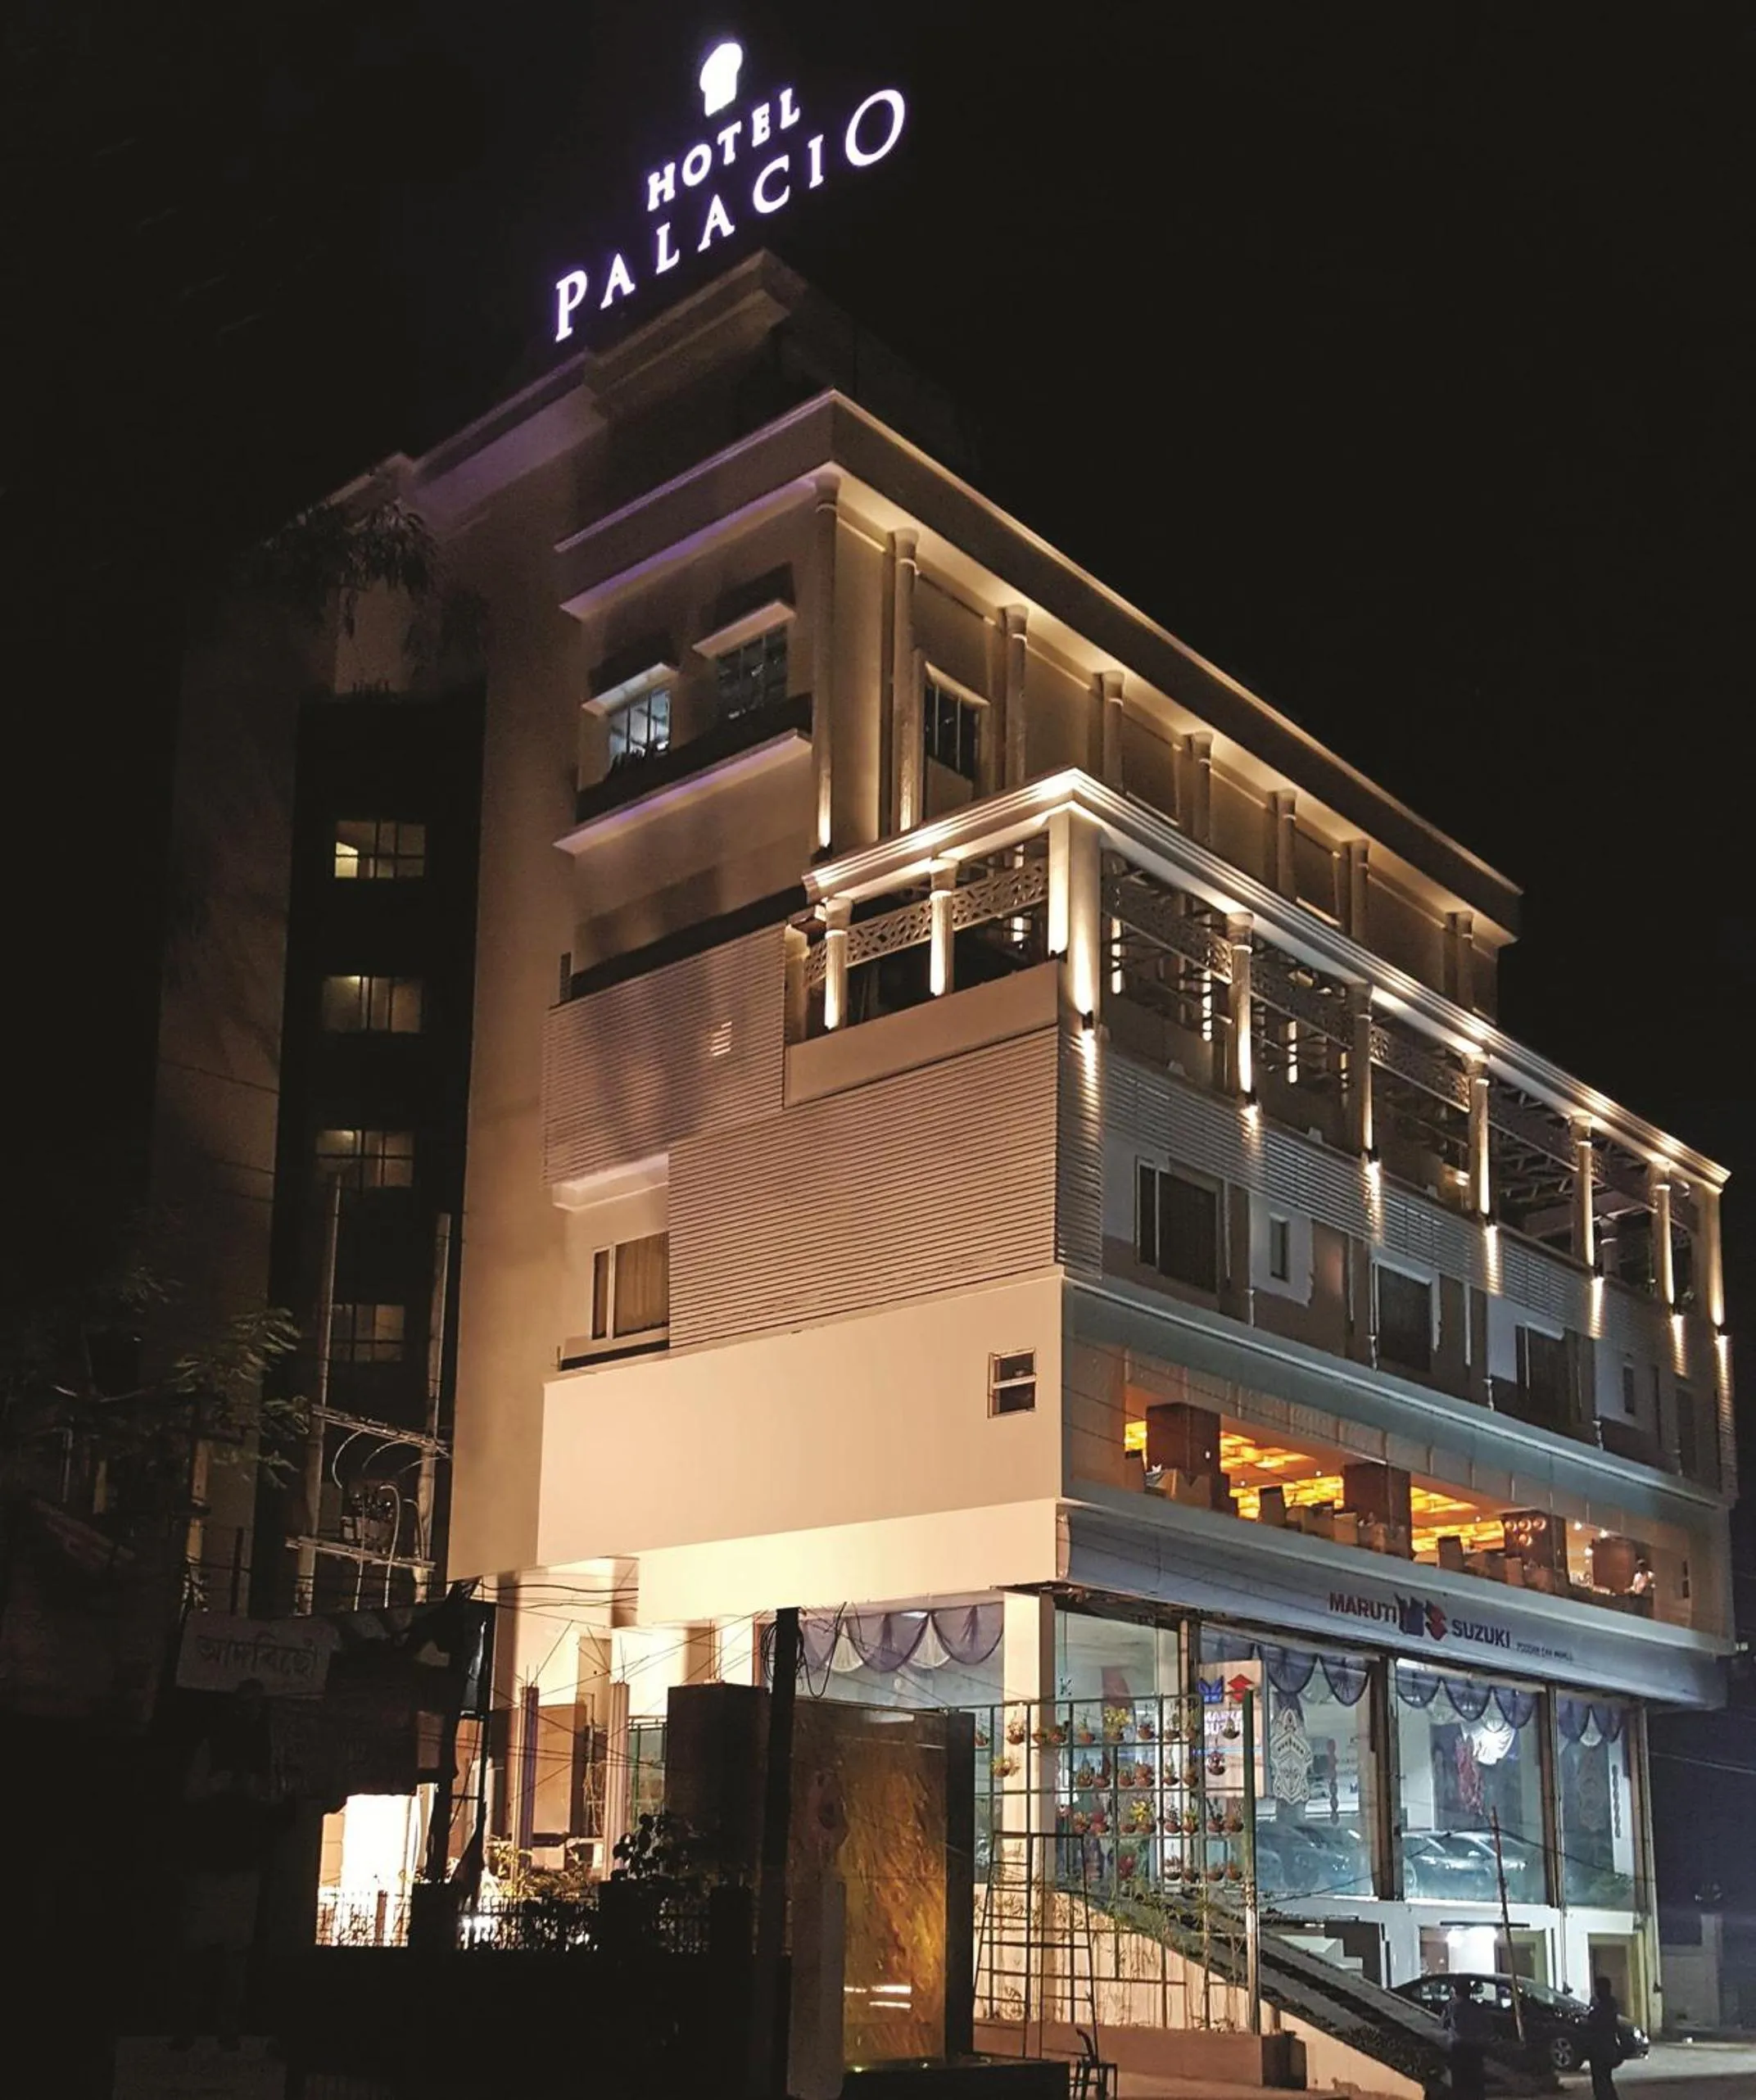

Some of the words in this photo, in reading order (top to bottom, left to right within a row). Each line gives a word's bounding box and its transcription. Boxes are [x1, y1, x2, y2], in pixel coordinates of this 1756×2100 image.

[647, 87, 801, 212] HOTEL
[555, 88, 905, 342] PALACIO
[1329, 1591, 1397, 1624] MARUTI
[1451, 1618, 1510, 1649] SUZUKI
